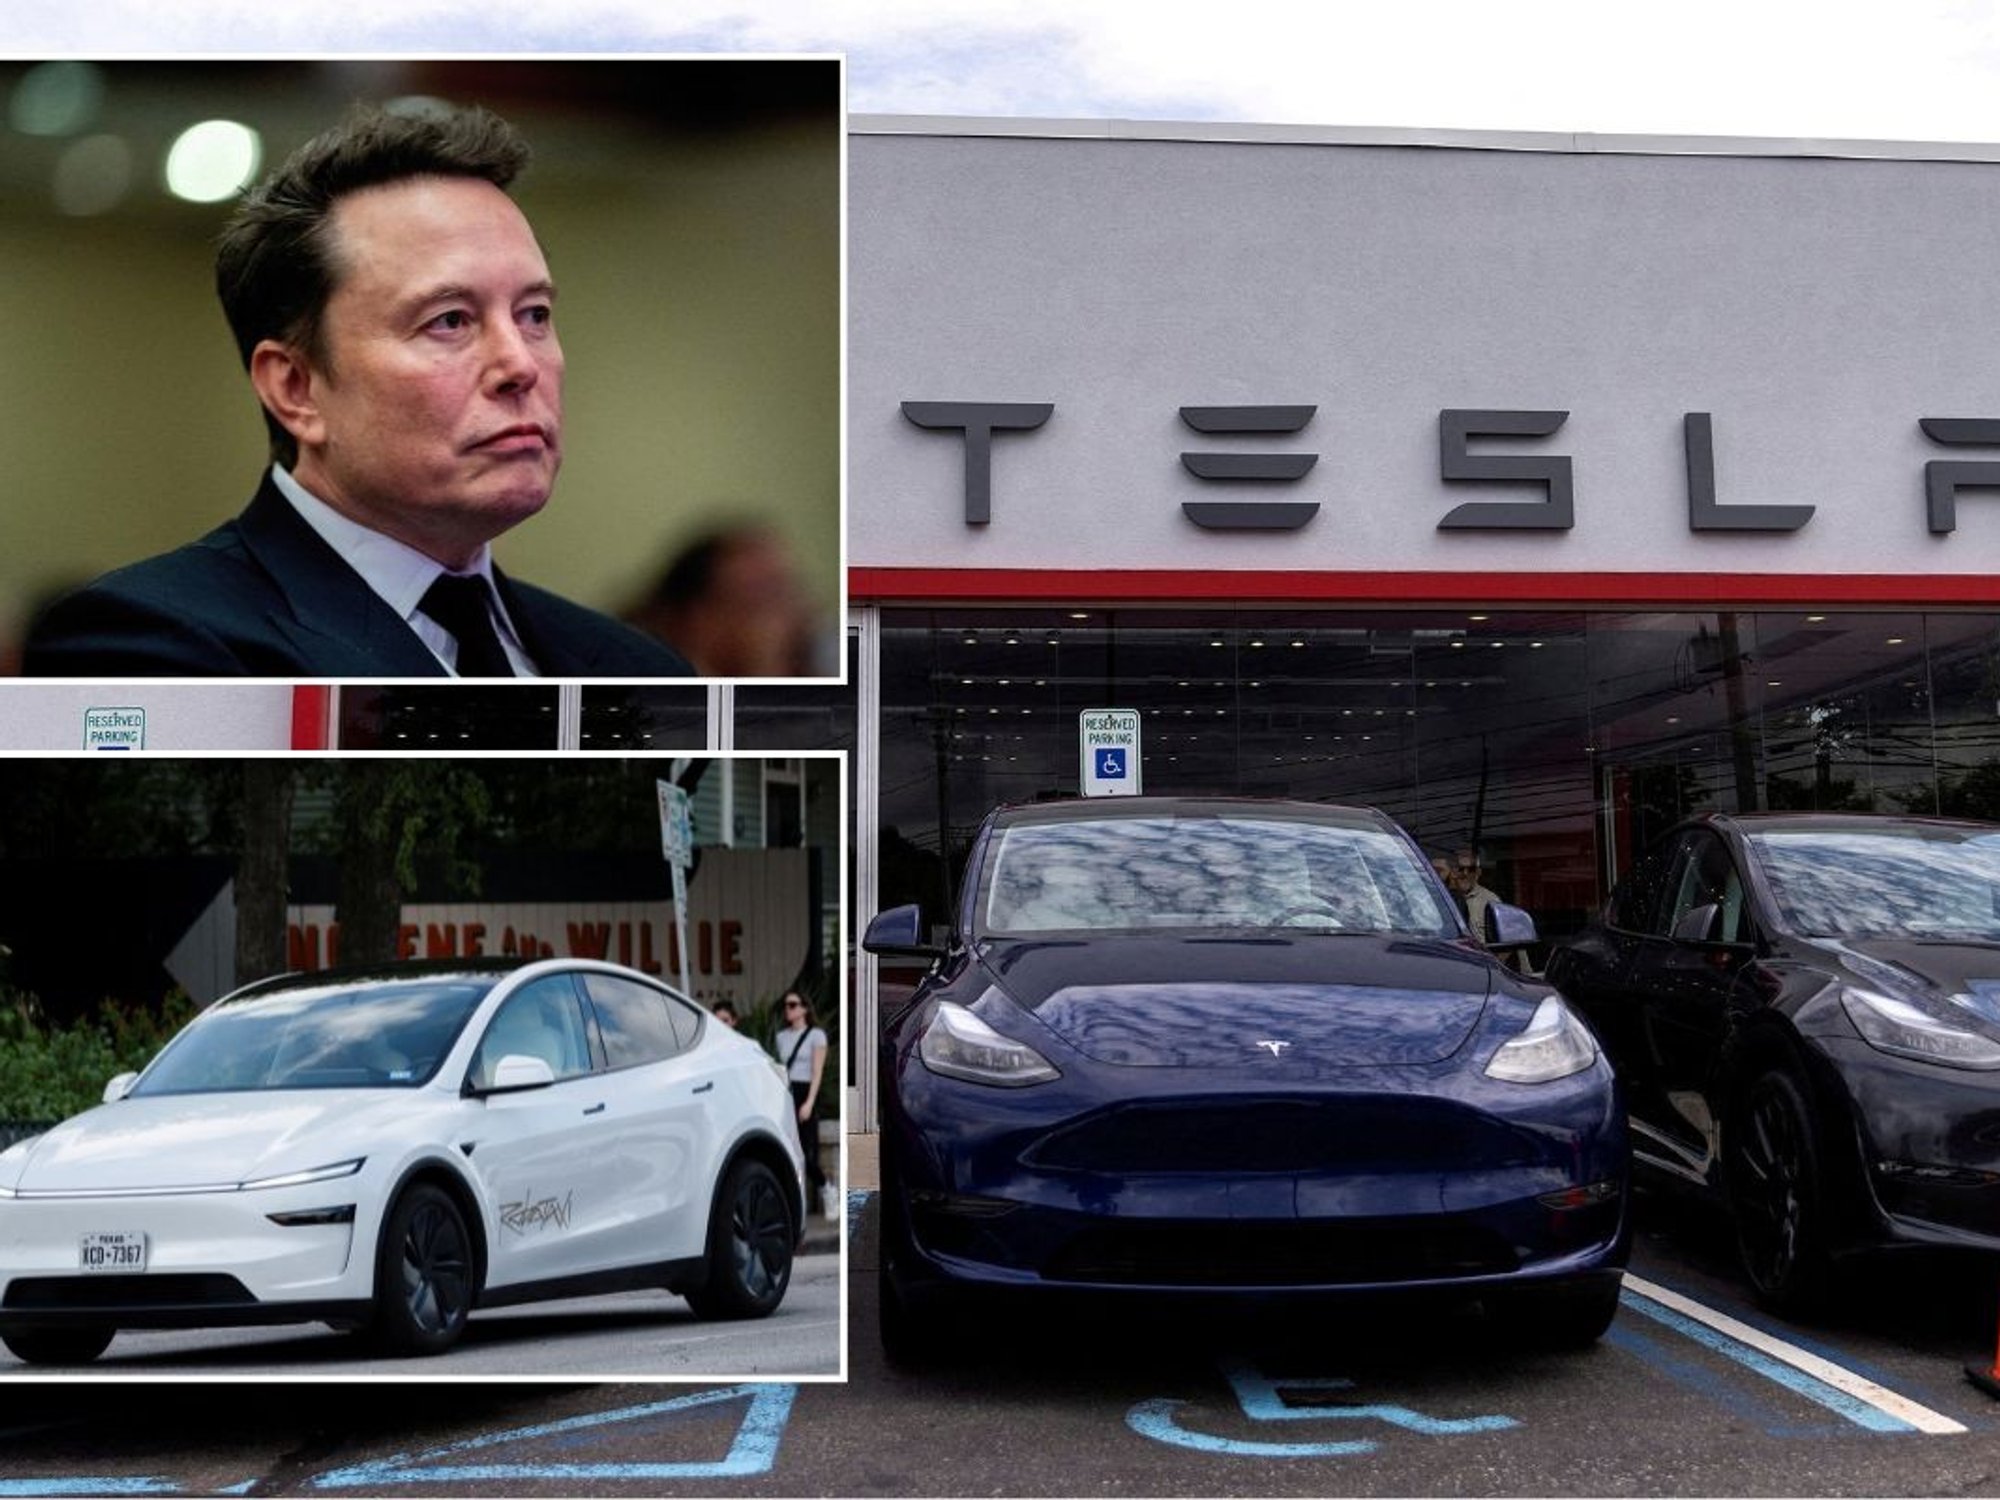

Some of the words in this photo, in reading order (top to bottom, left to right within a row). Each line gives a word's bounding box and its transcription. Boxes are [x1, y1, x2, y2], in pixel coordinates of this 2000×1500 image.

[901, 402, 2000, 536] TESLA
[88, 716, 142, 727] RESERVED
[1086, 718, 1135, 730] RESERVED
[91, 731, 138, 742] PARKING
[1089, 733, 1132, 744] PARKING
